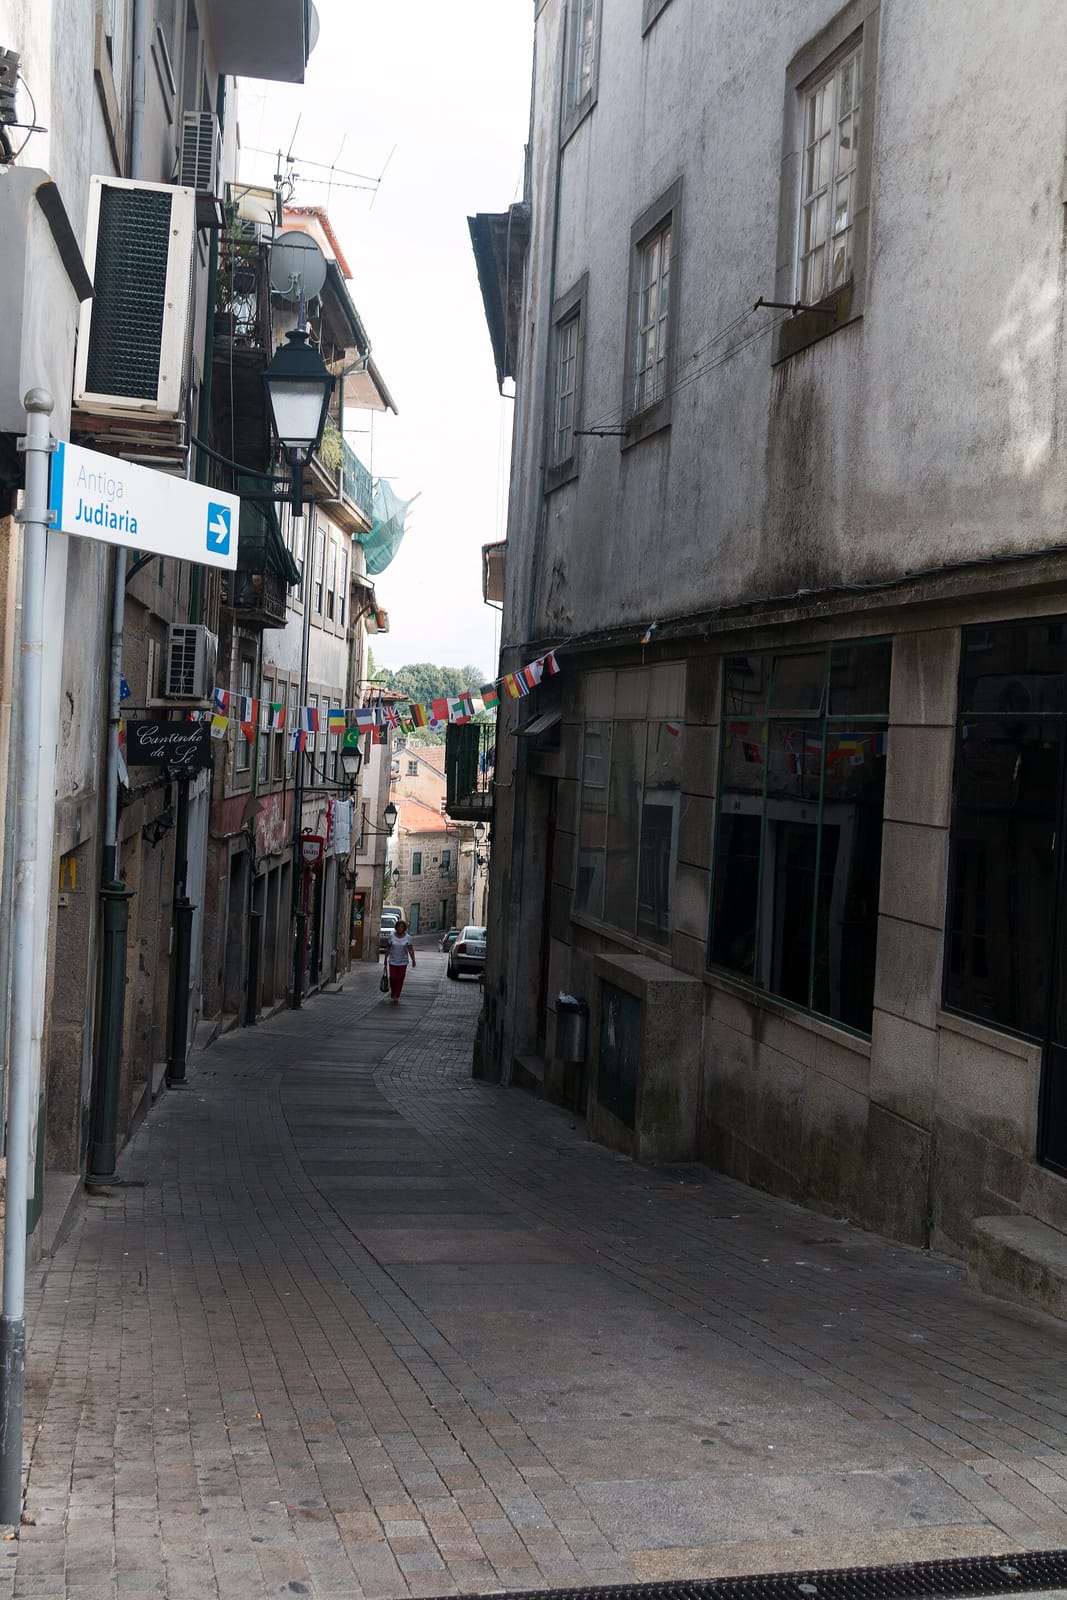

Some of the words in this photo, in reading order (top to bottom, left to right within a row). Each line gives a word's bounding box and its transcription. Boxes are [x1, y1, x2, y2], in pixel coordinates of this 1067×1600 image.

[77, 465, 124, 502] Antiga
[75, 498, 138, 535] Judiaria
[150, 745, 165, 757] da
[170, 745, 198, 764] Sé
